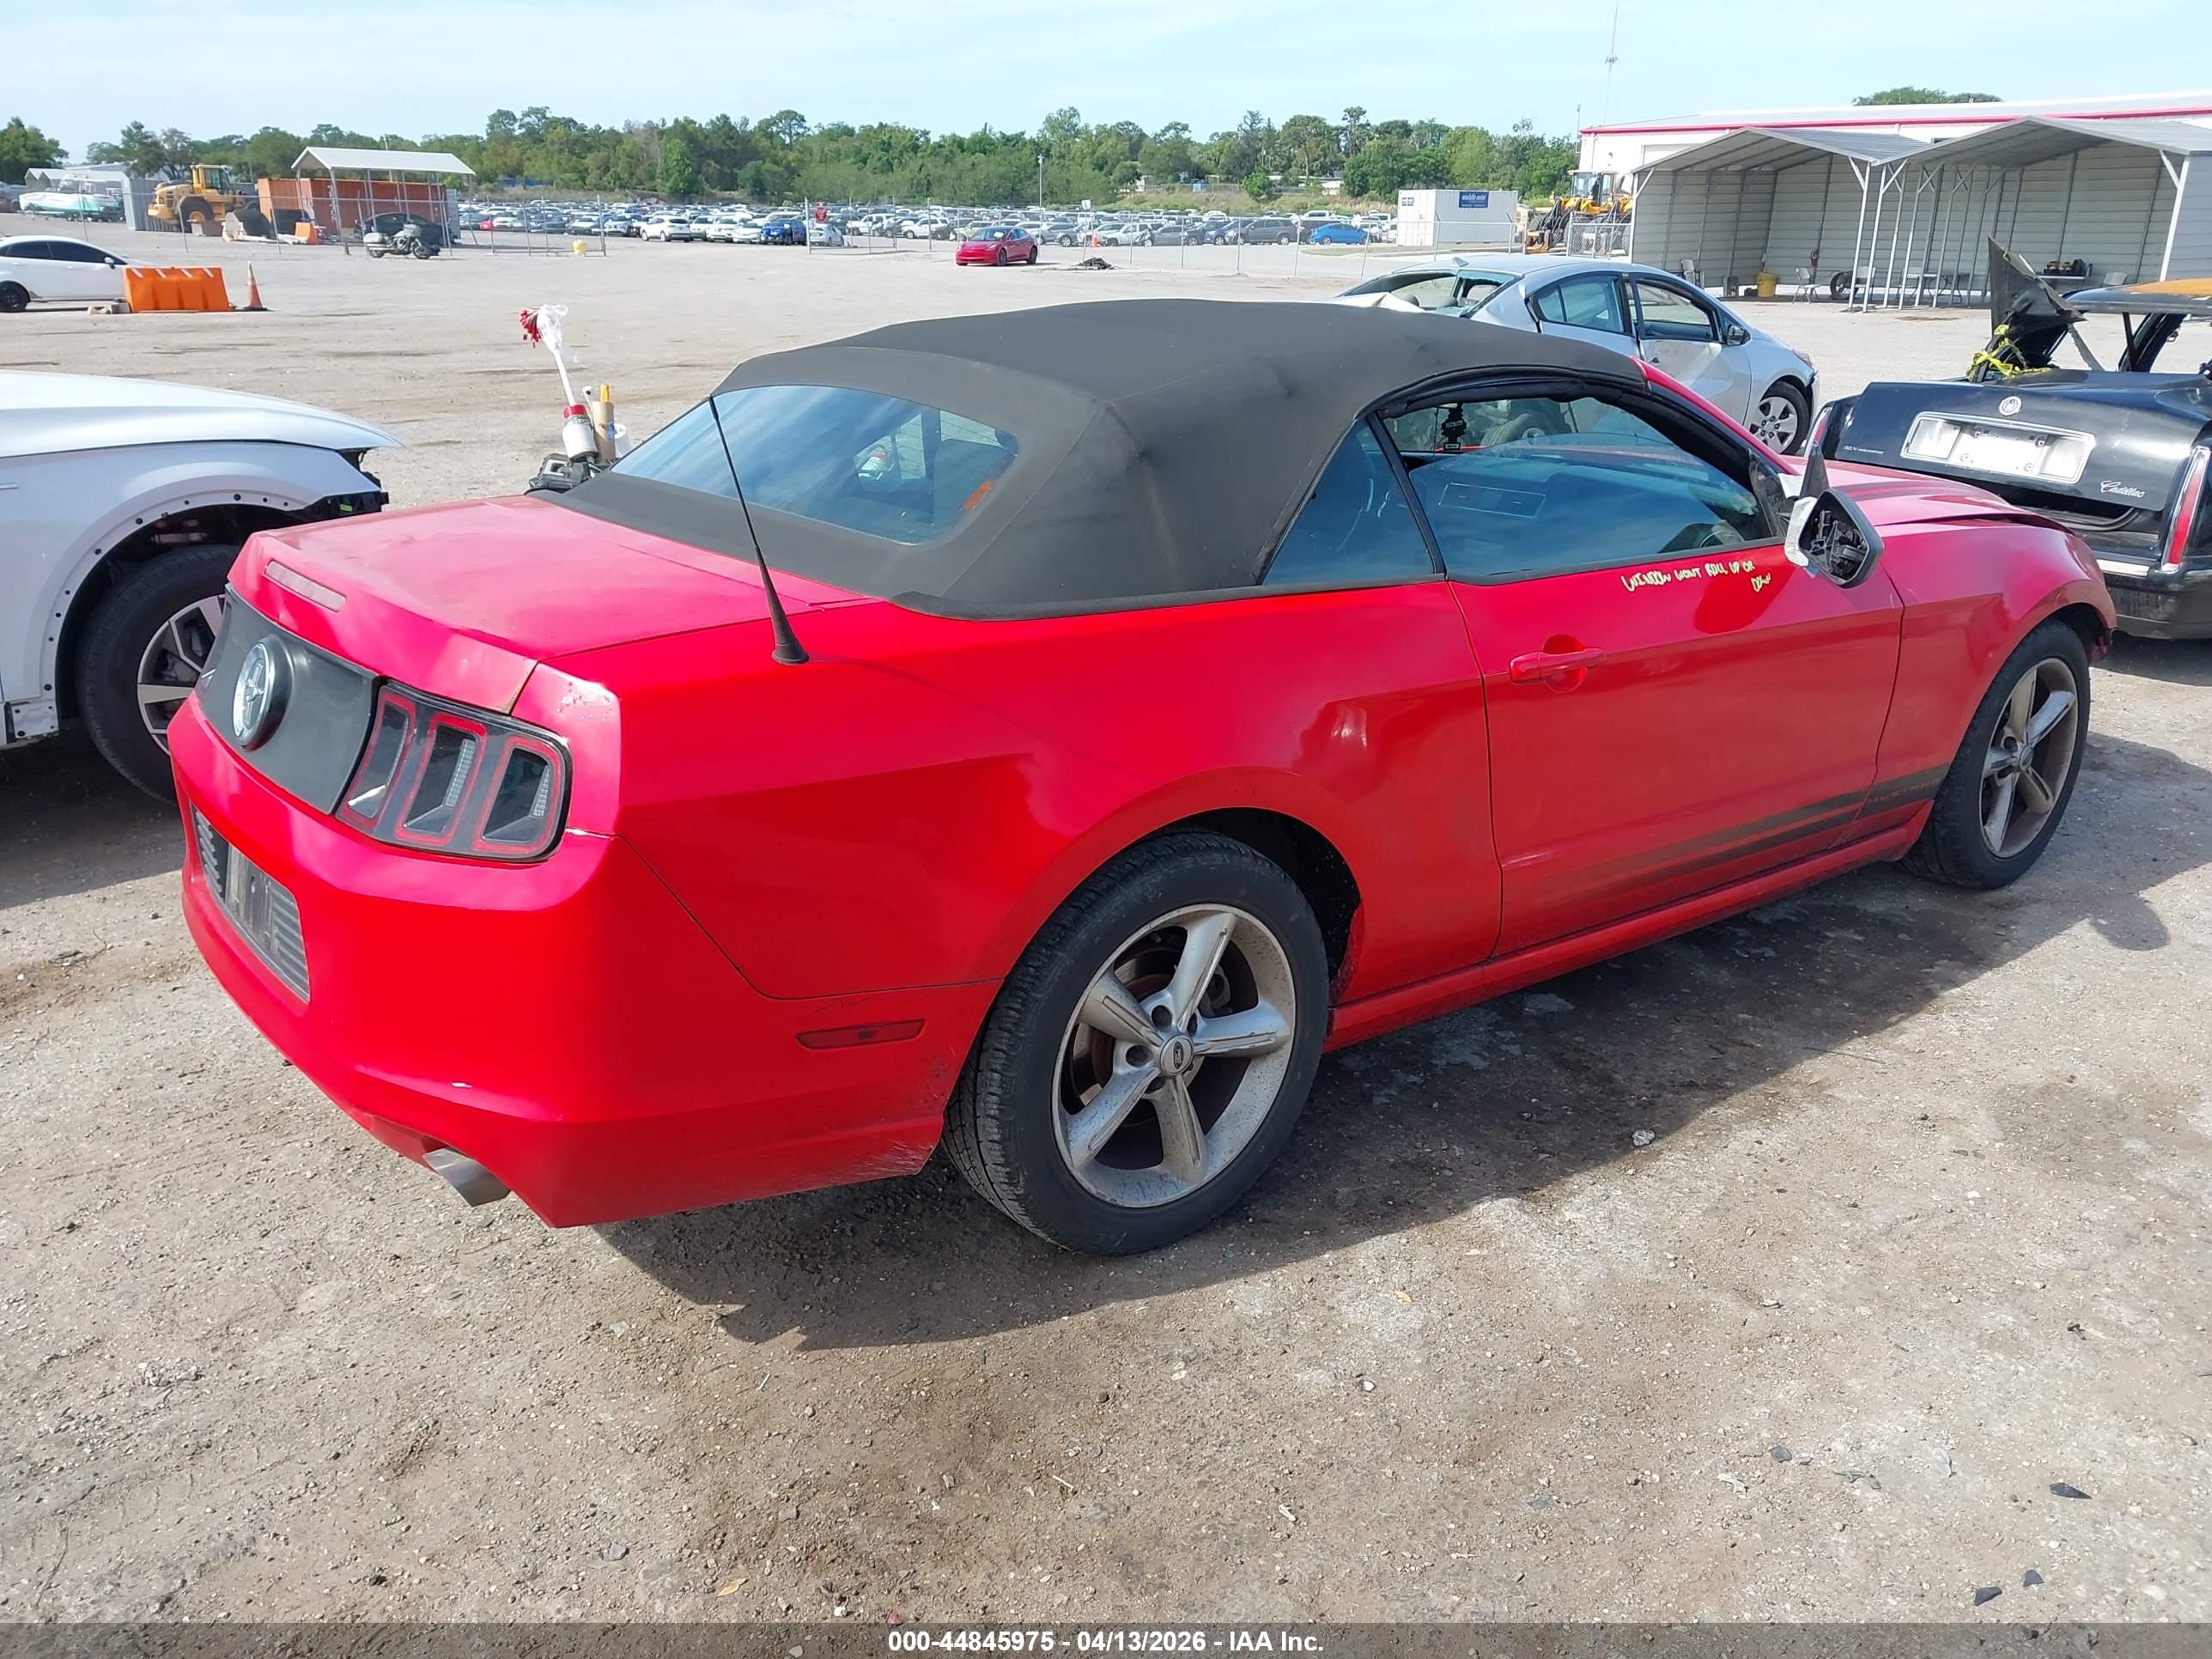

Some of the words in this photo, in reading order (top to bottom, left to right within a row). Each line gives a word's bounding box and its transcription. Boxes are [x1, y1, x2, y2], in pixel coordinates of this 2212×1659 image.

[2100, 480, 2145, 498] Cadillac
[1705, 562, 1729, 577] ROLL
[1729, 561, 1740, 574] UP
[1742, 560, 1756, 572] OR
